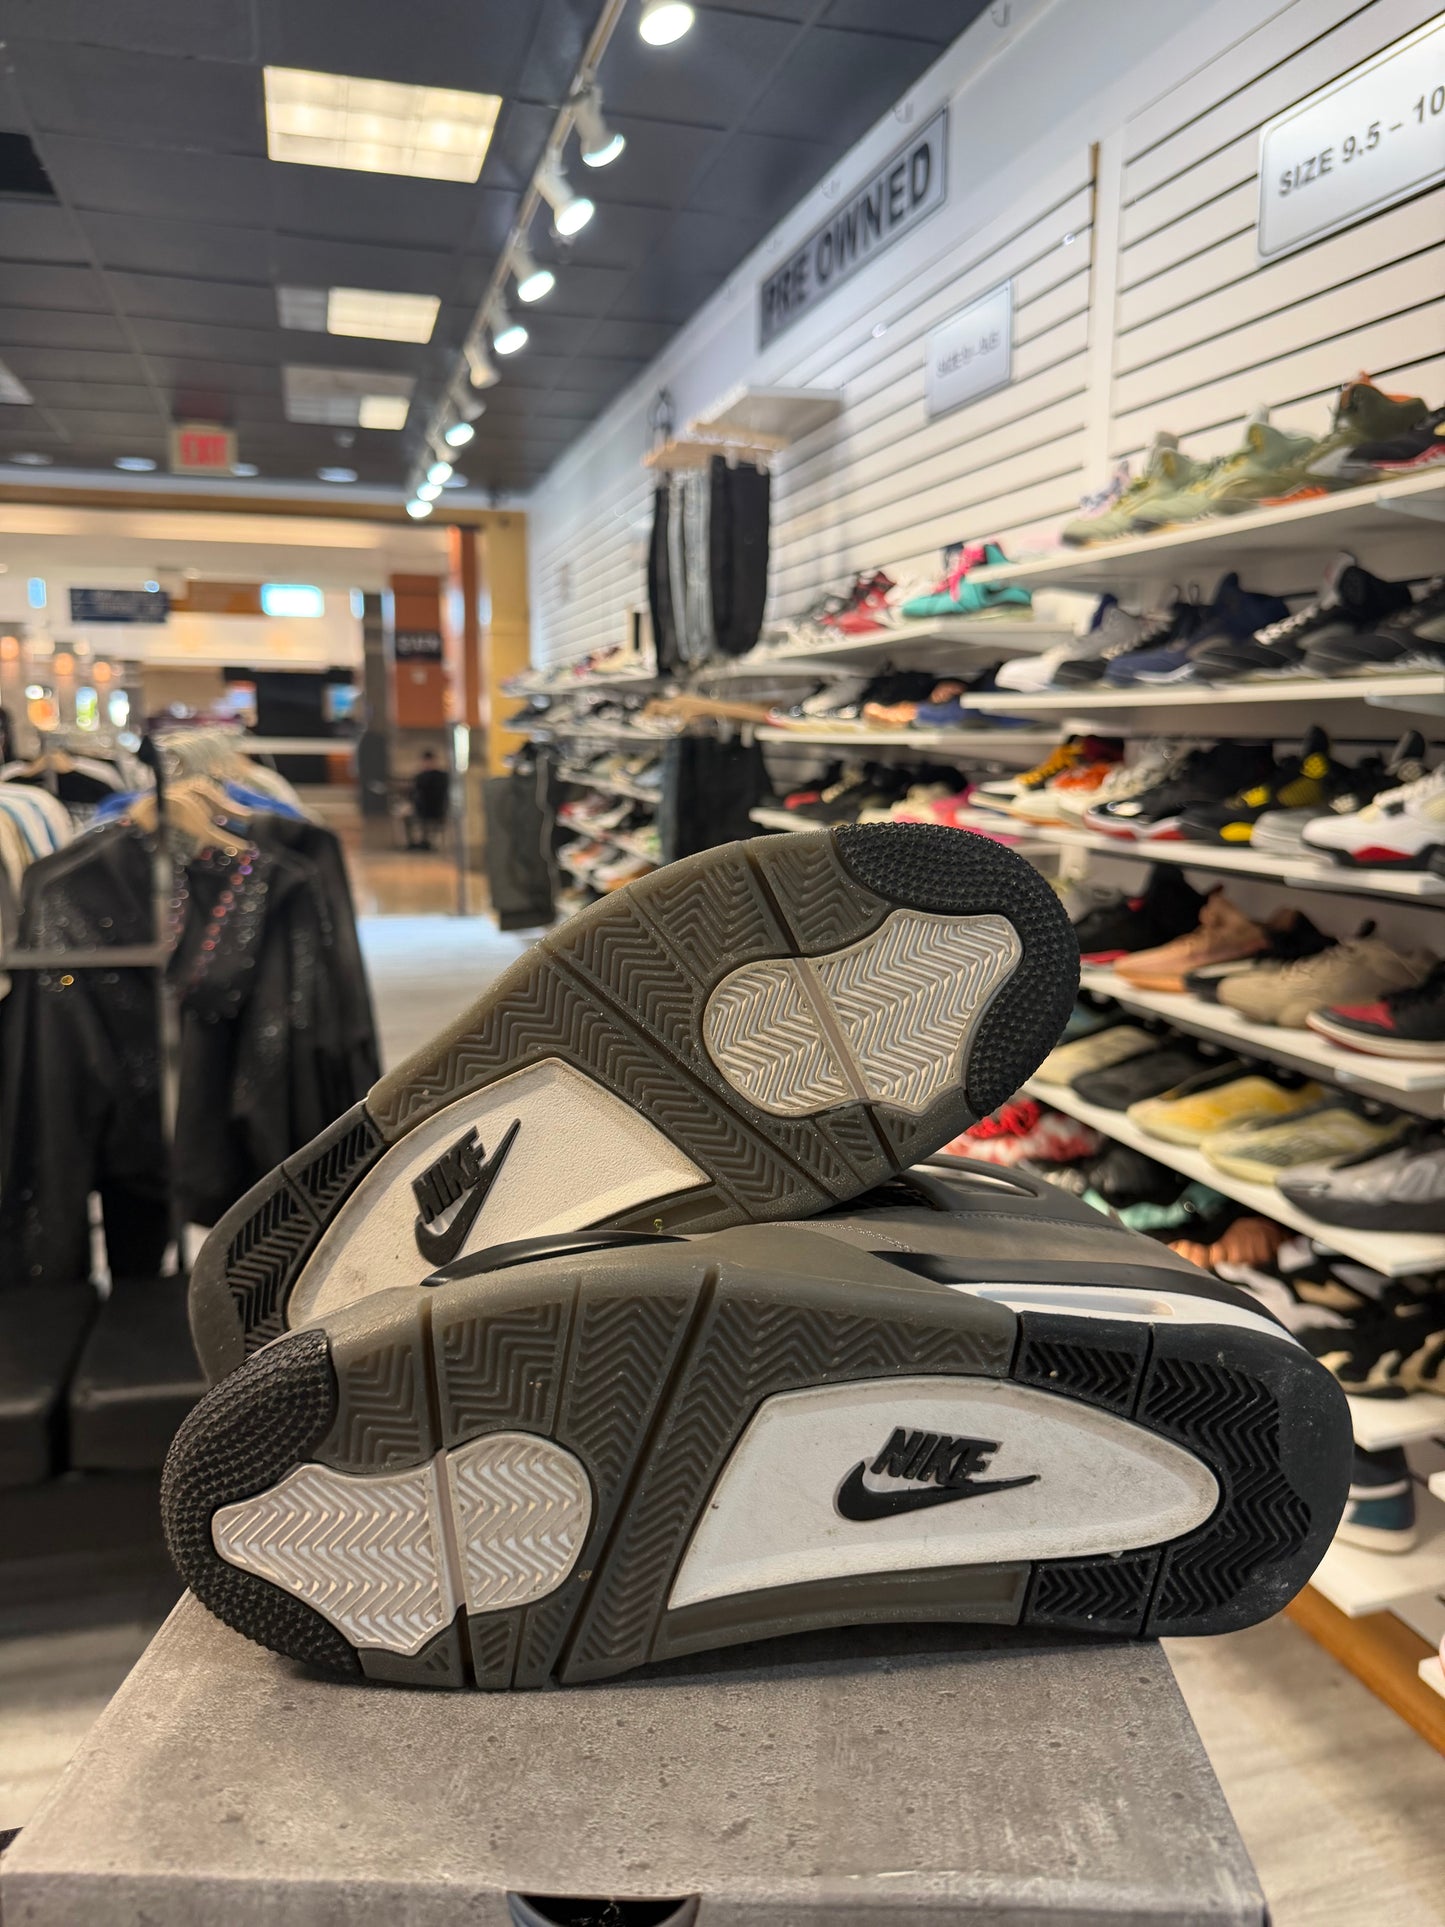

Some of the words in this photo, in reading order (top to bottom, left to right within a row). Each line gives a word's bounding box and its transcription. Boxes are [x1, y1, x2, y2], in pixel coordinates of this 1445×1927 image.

[1279, 147, 1334, 197] SIZE
[1342, 121, 1381, 164] 9.5
[1413, 85, 1445, 124] 10
[764, 253, 809, 317] PRE
[815, 142, 931, 284] OWNED
[411, 1125, 487, 1225] NIKE
[869, 1426, 1003, 1488] NIKE
